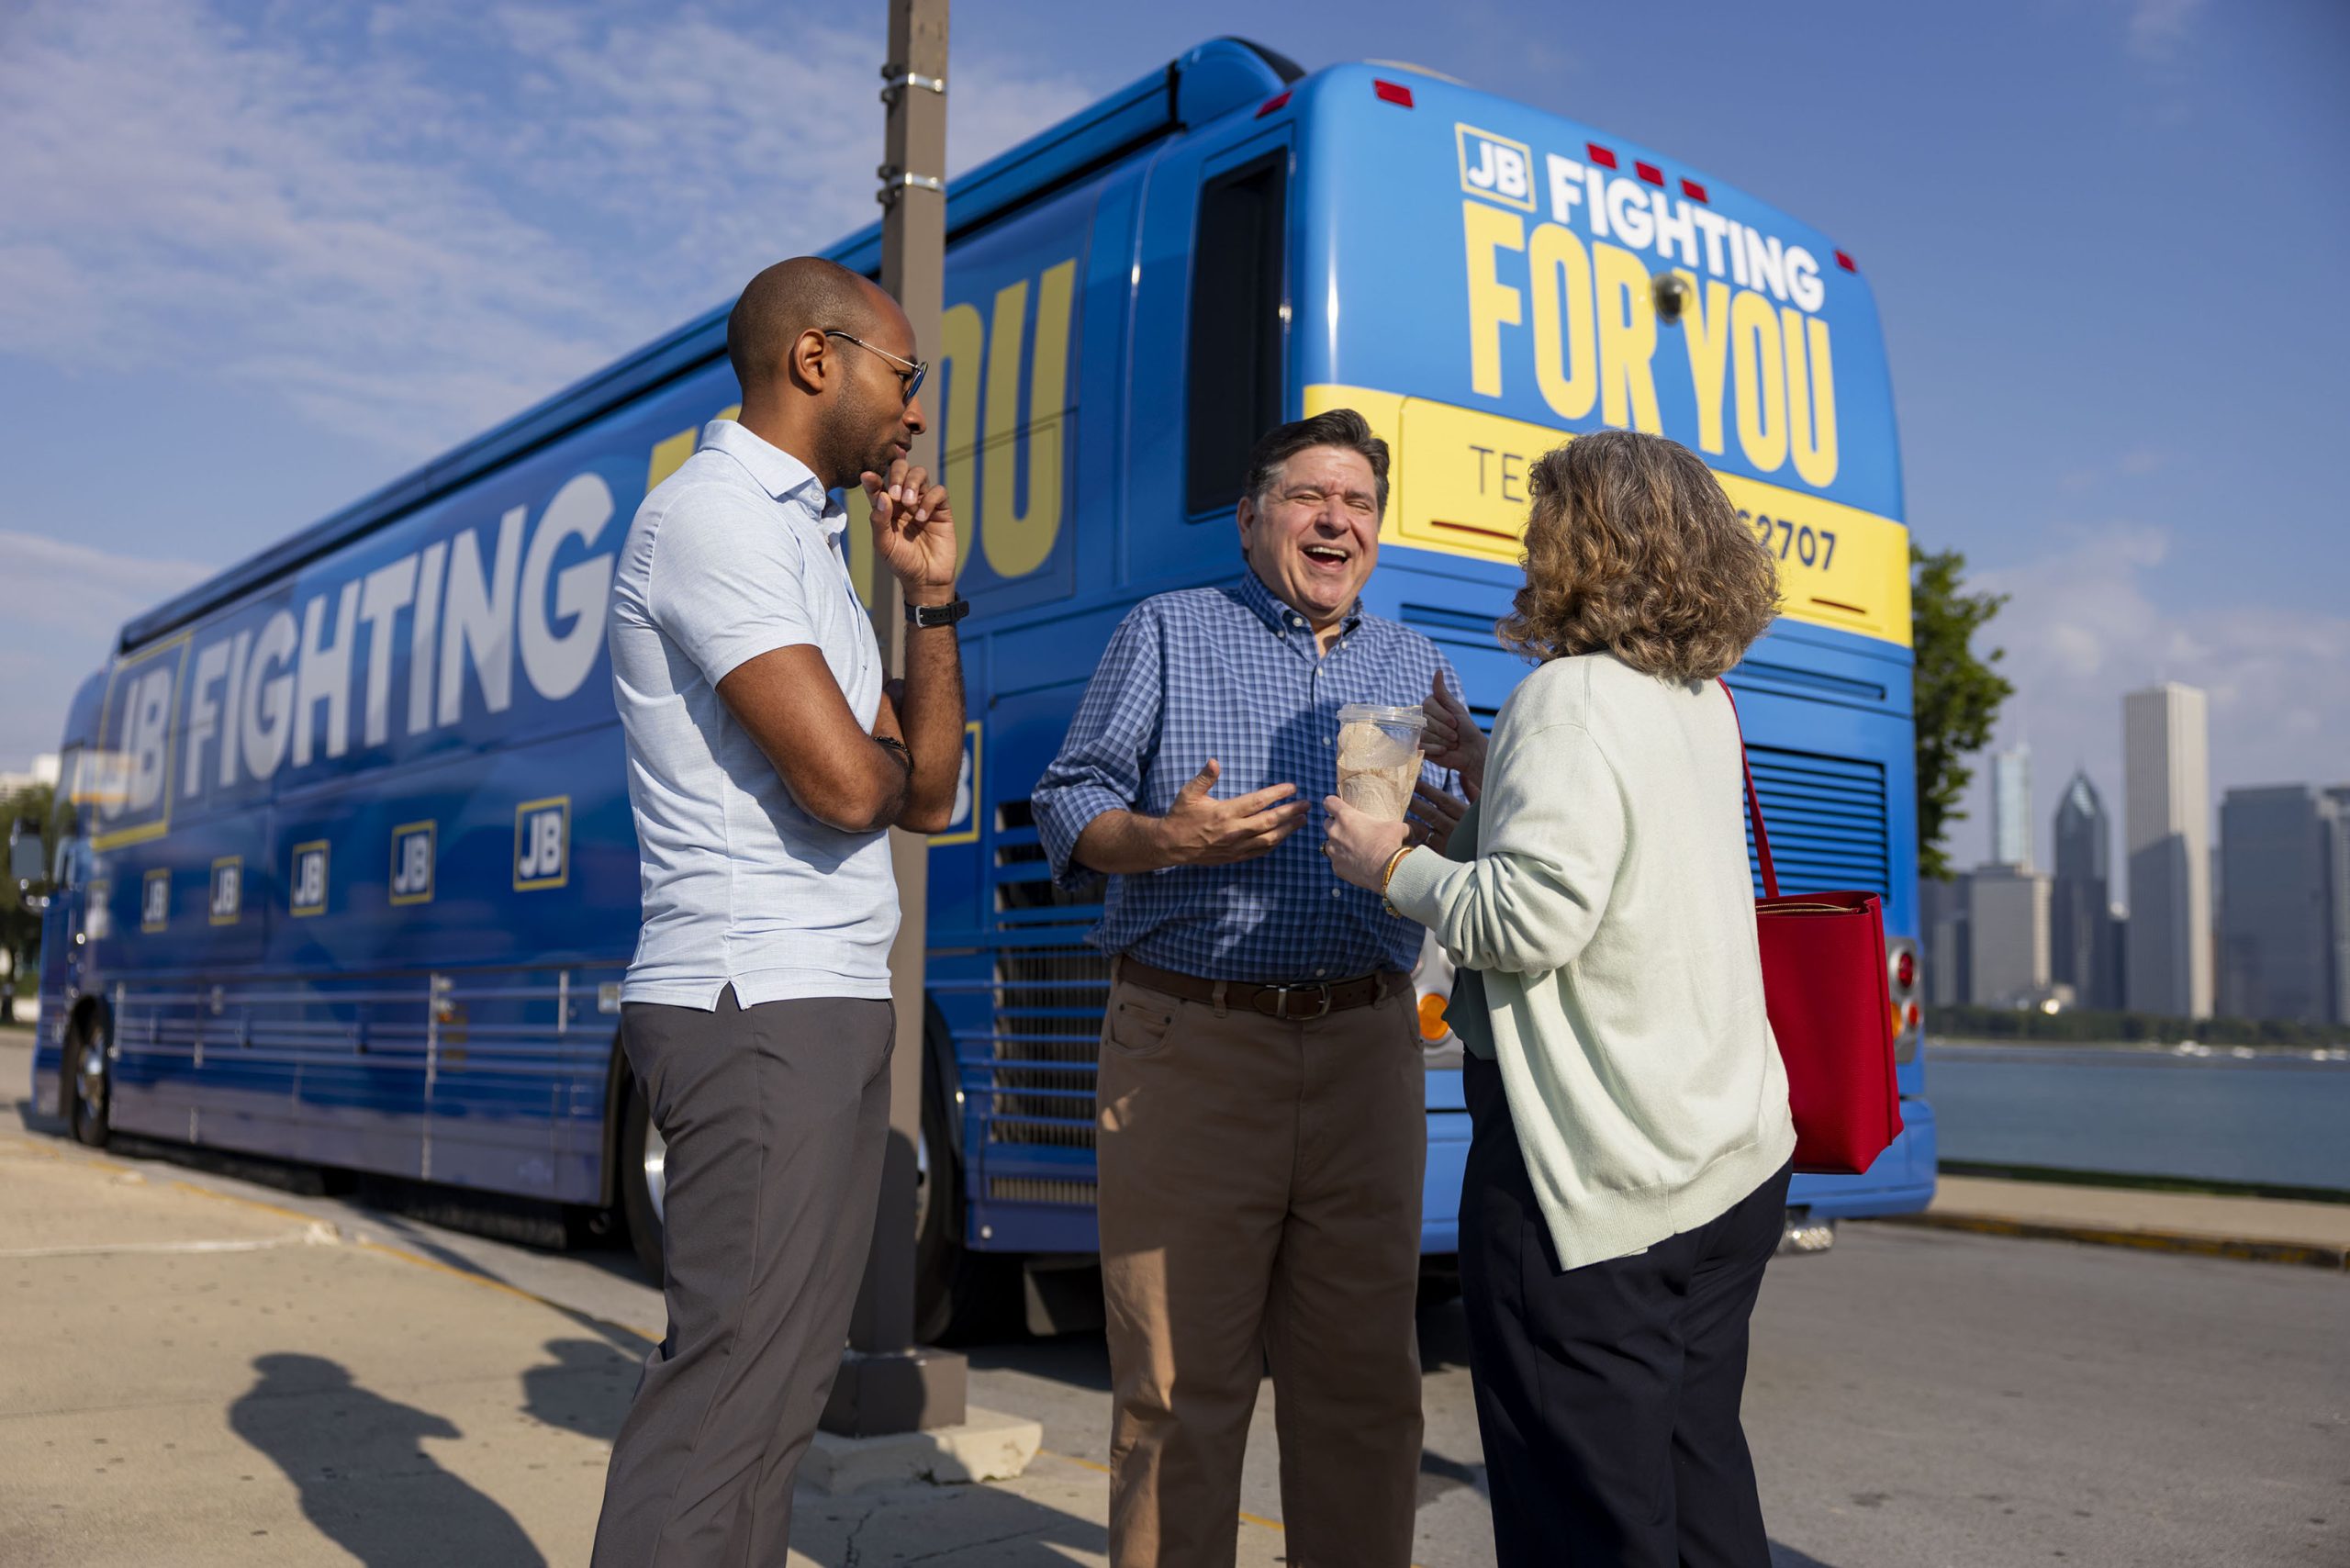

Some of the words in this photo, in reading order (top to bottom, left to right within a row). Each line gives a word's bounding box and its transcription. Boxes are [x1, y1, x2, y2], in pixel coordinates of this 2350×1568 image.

[1468, 140, 1528, 198] JB
[1546, 152, 1825, 314] FIGHTING
[1462, 198, 1663, 437] FOR
[1671, 266, 1839, 488] YOU
[100, 665, 173, 821] JB
[185, 472, 615, 799] FIGHTING
[294, 852, 324, 906] JB
[394, 834, 430, 894] JB
[519, 811, 563, 879] JB
[212, 867, 238, 916] JB
